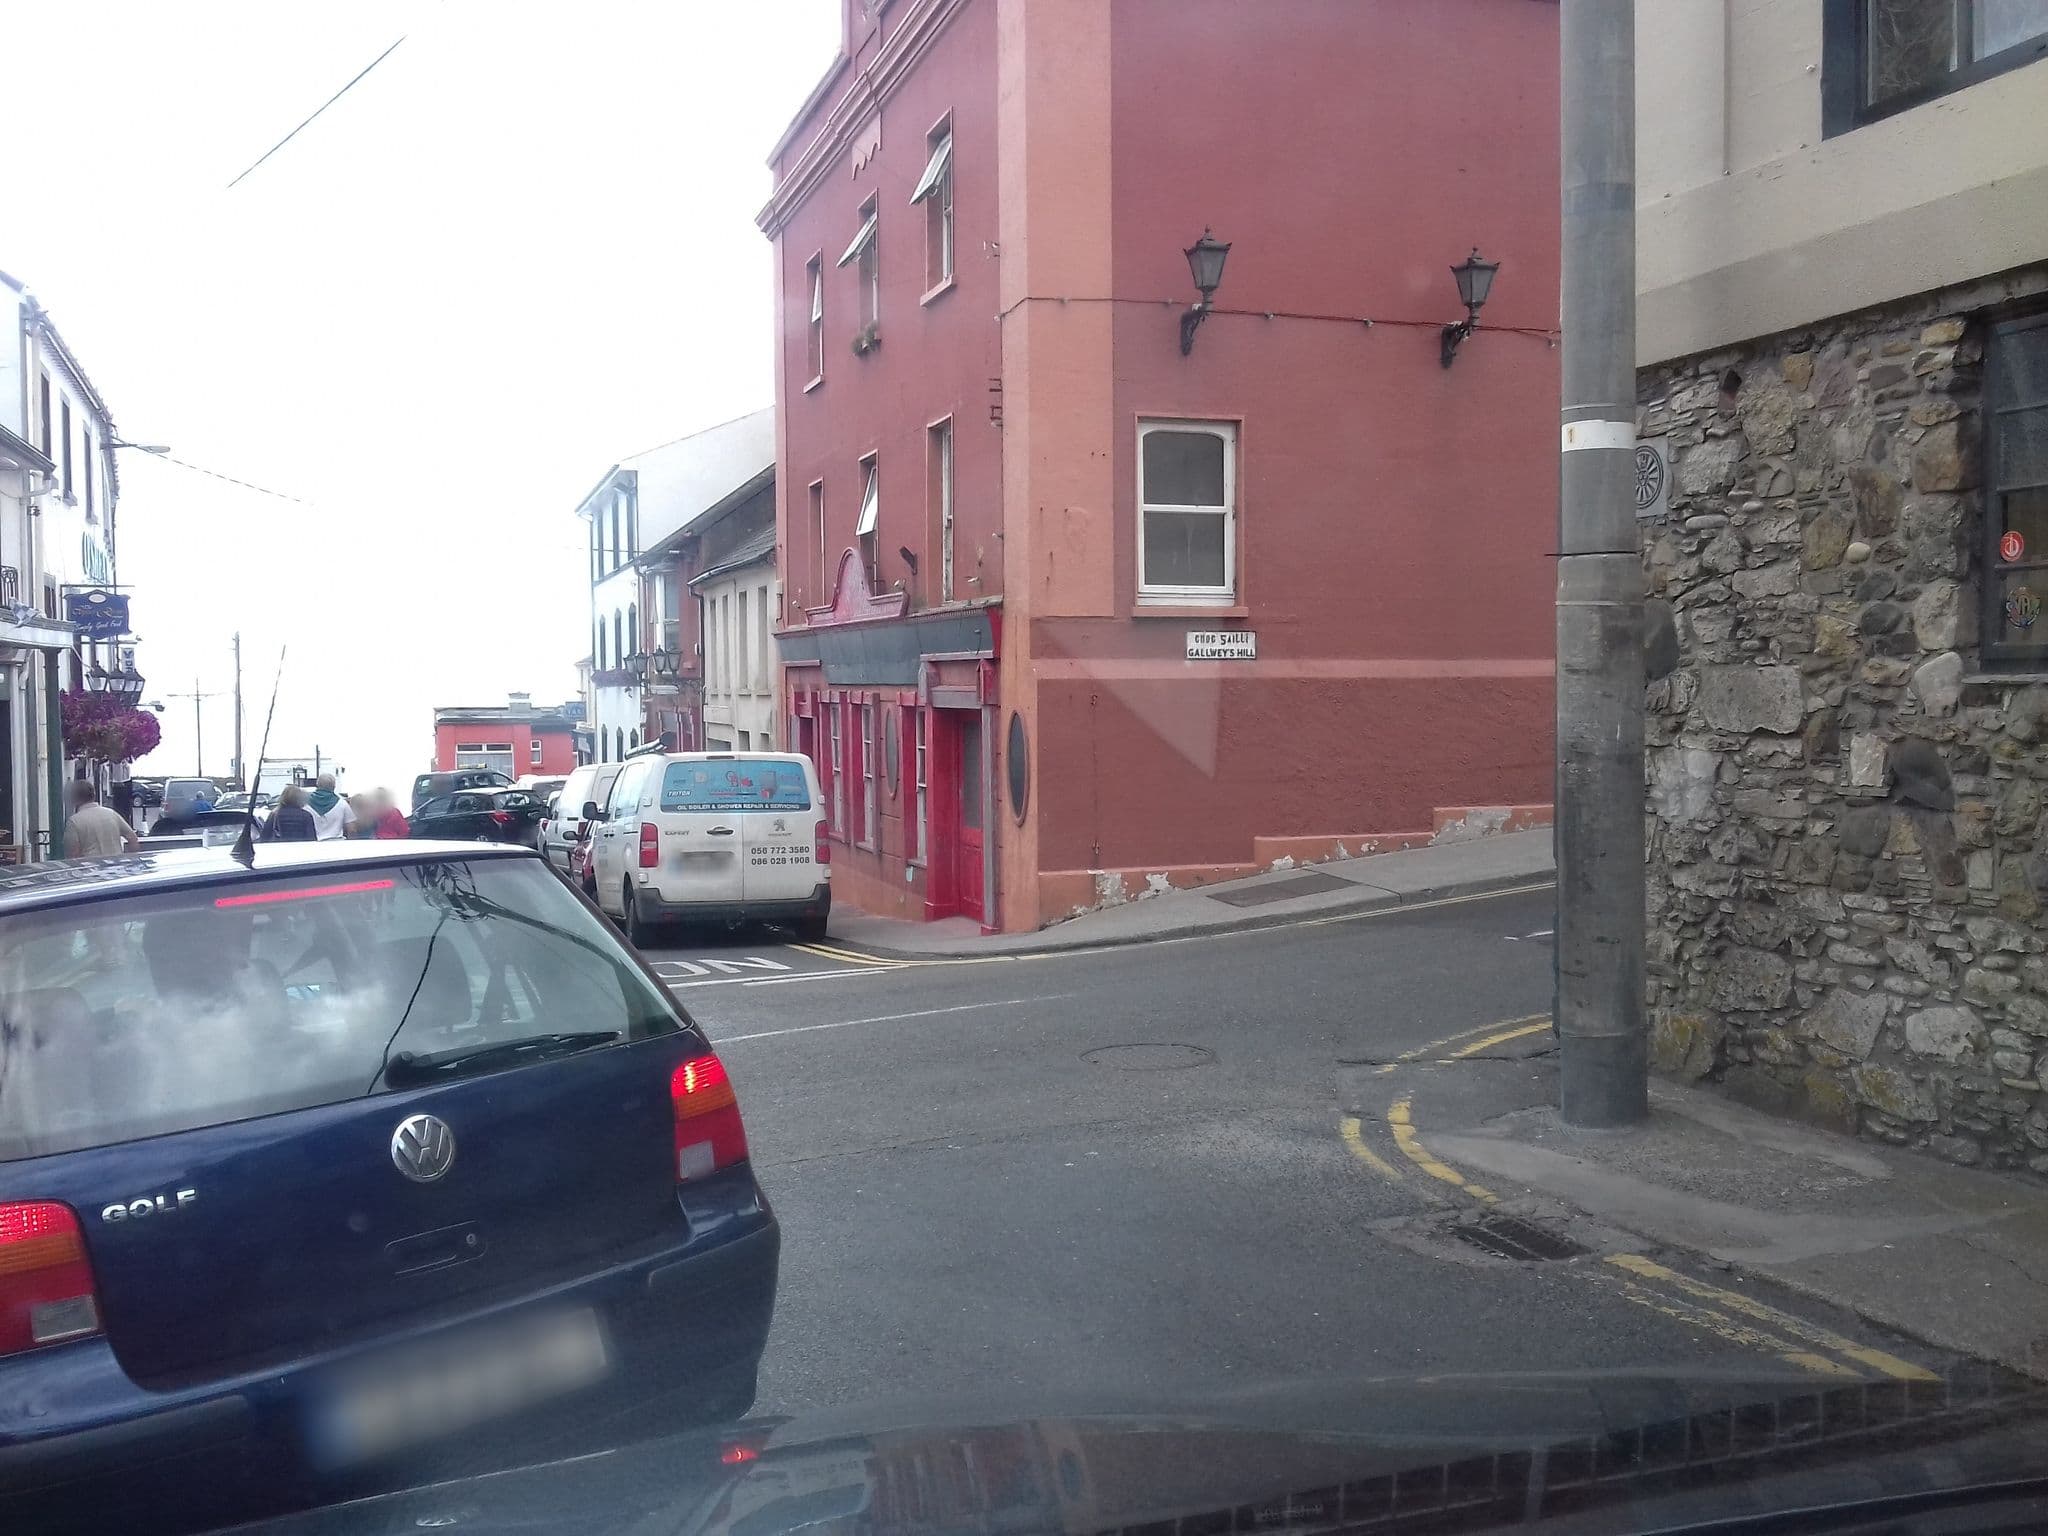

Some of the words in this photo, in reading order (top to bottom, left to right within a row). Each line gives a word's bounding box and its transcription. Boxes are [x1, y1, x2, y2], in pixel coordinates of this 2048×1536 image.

[1188, 648, 1235, 657] GALLWEY'S
[1237, 648, 1255, 657] HILL
[770, 846, 787, 854] 772
[101, 1188, 197, 1224] GOLF
